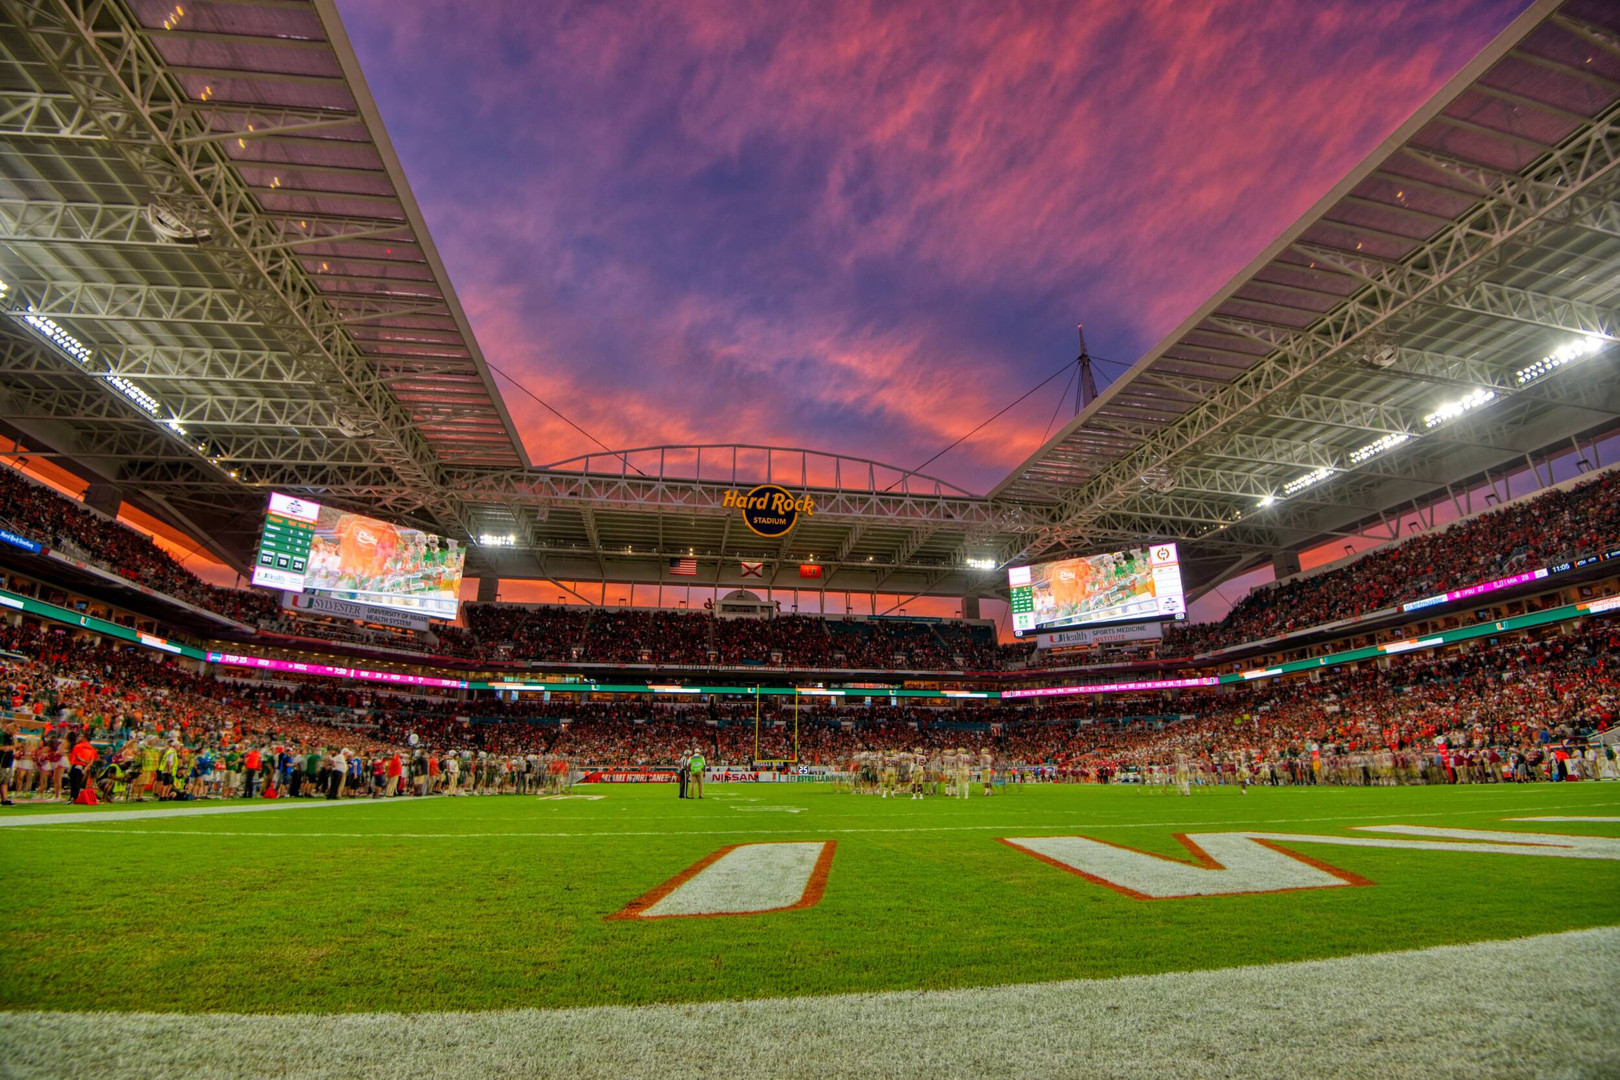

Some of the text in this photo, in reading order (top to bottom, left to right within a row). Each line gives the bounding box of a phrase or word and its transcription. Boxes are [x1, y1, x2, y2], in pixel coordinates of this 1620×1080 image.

[722, 489, 815, 516] Hard Rock
[753, 517, 786, 525] STADIUM
[314, 598, 361, 615] SYLVESTER
[367, 607, 401, 619] UNIVERSITY
[410, 614, 429, 622] MIAMI
[366, 615, 411, 627] HEALTH SYSTEM
[1092, 625, 1148, 636] SPORTS MEDICINE
[1093, 634, 1126, 643] INSTITUTE
[799, 766, 808, 774] 25
[602, 774, 627, 783] MIAMI
[712, 773, 757, 782] NISSAN
